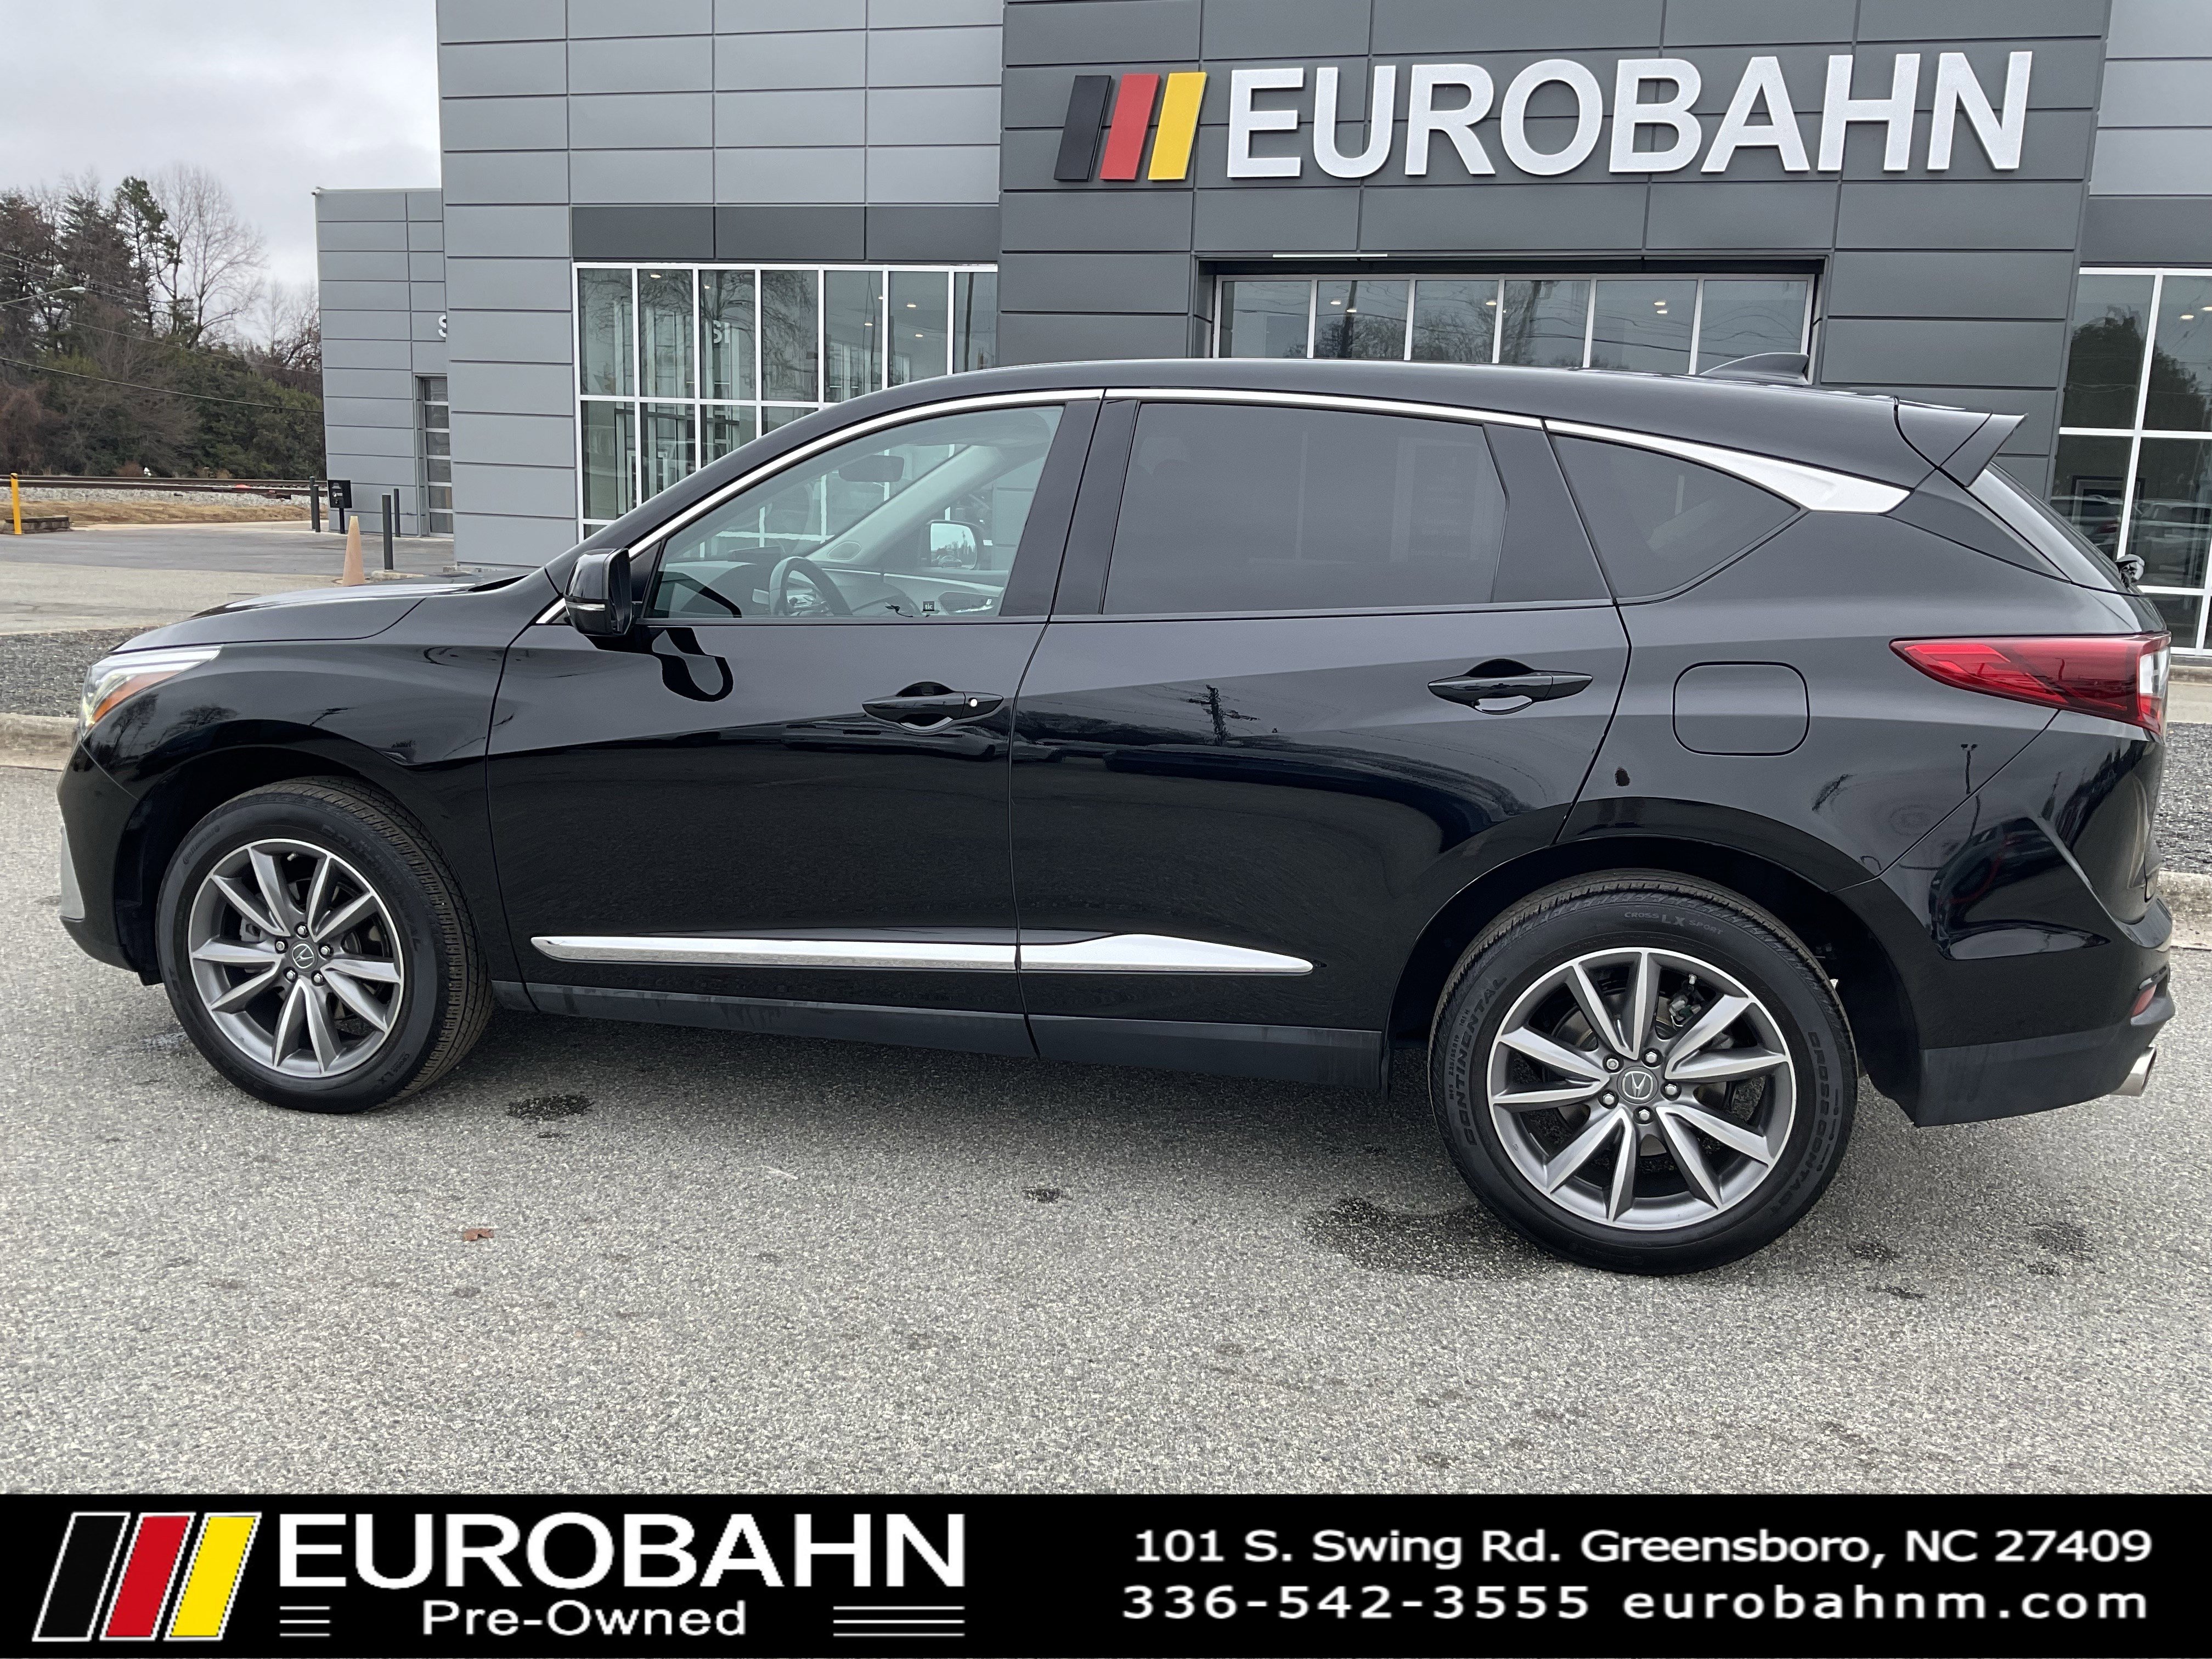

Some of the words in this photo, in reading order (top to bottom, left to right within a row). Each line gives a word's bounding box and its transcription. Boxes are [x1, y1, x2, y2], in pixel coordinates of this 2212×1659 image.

[1227, 51, 2032, 178] EUROBAHN
[1624, 911, 1660, 919] CROSS
[1455, 977, 1508, 1146] CONTINENTAL
